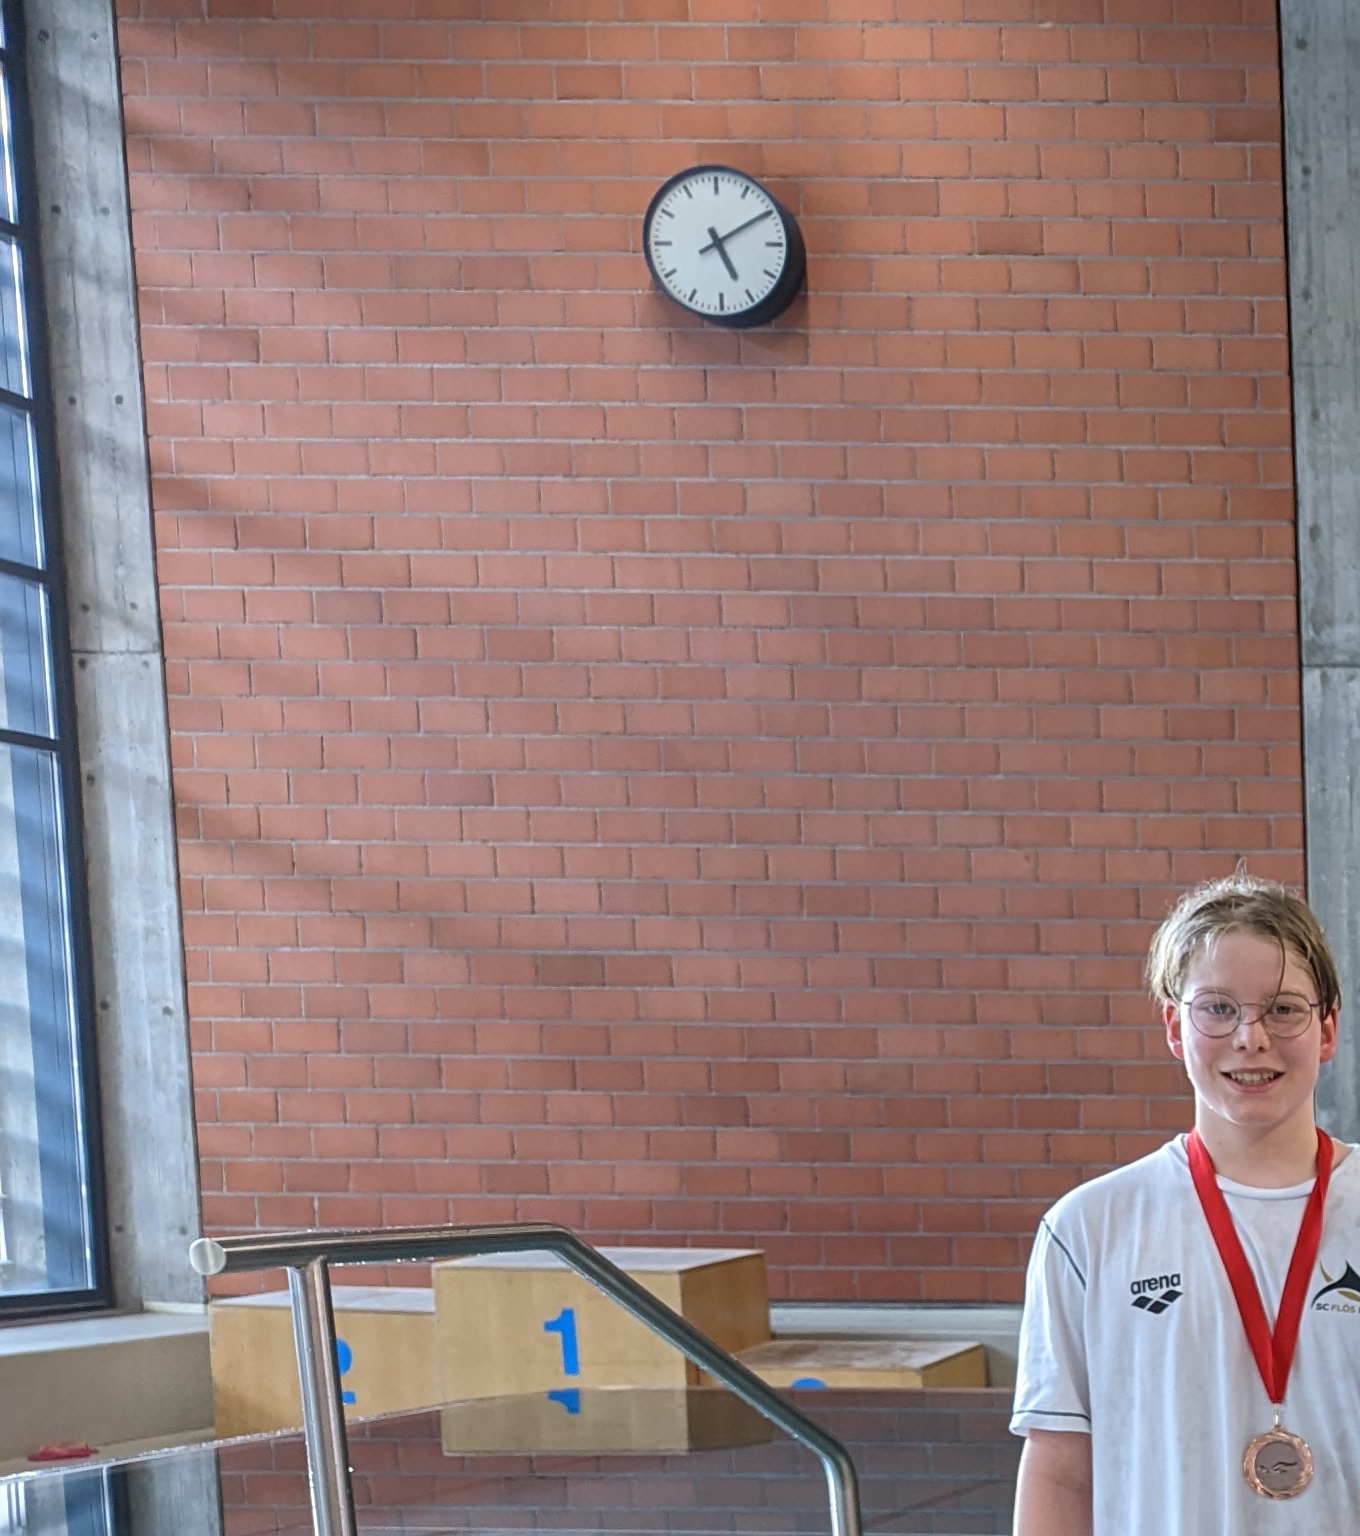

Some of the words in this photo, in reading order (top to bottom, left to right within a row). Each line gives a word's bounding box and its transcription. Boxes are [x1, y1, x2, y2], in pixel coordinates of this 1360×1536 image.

[1130, 1273, 1181, 1295] arena
[1315, 1303, 1329, 1311] SC
[544, 1308, 580, 1376] 1
